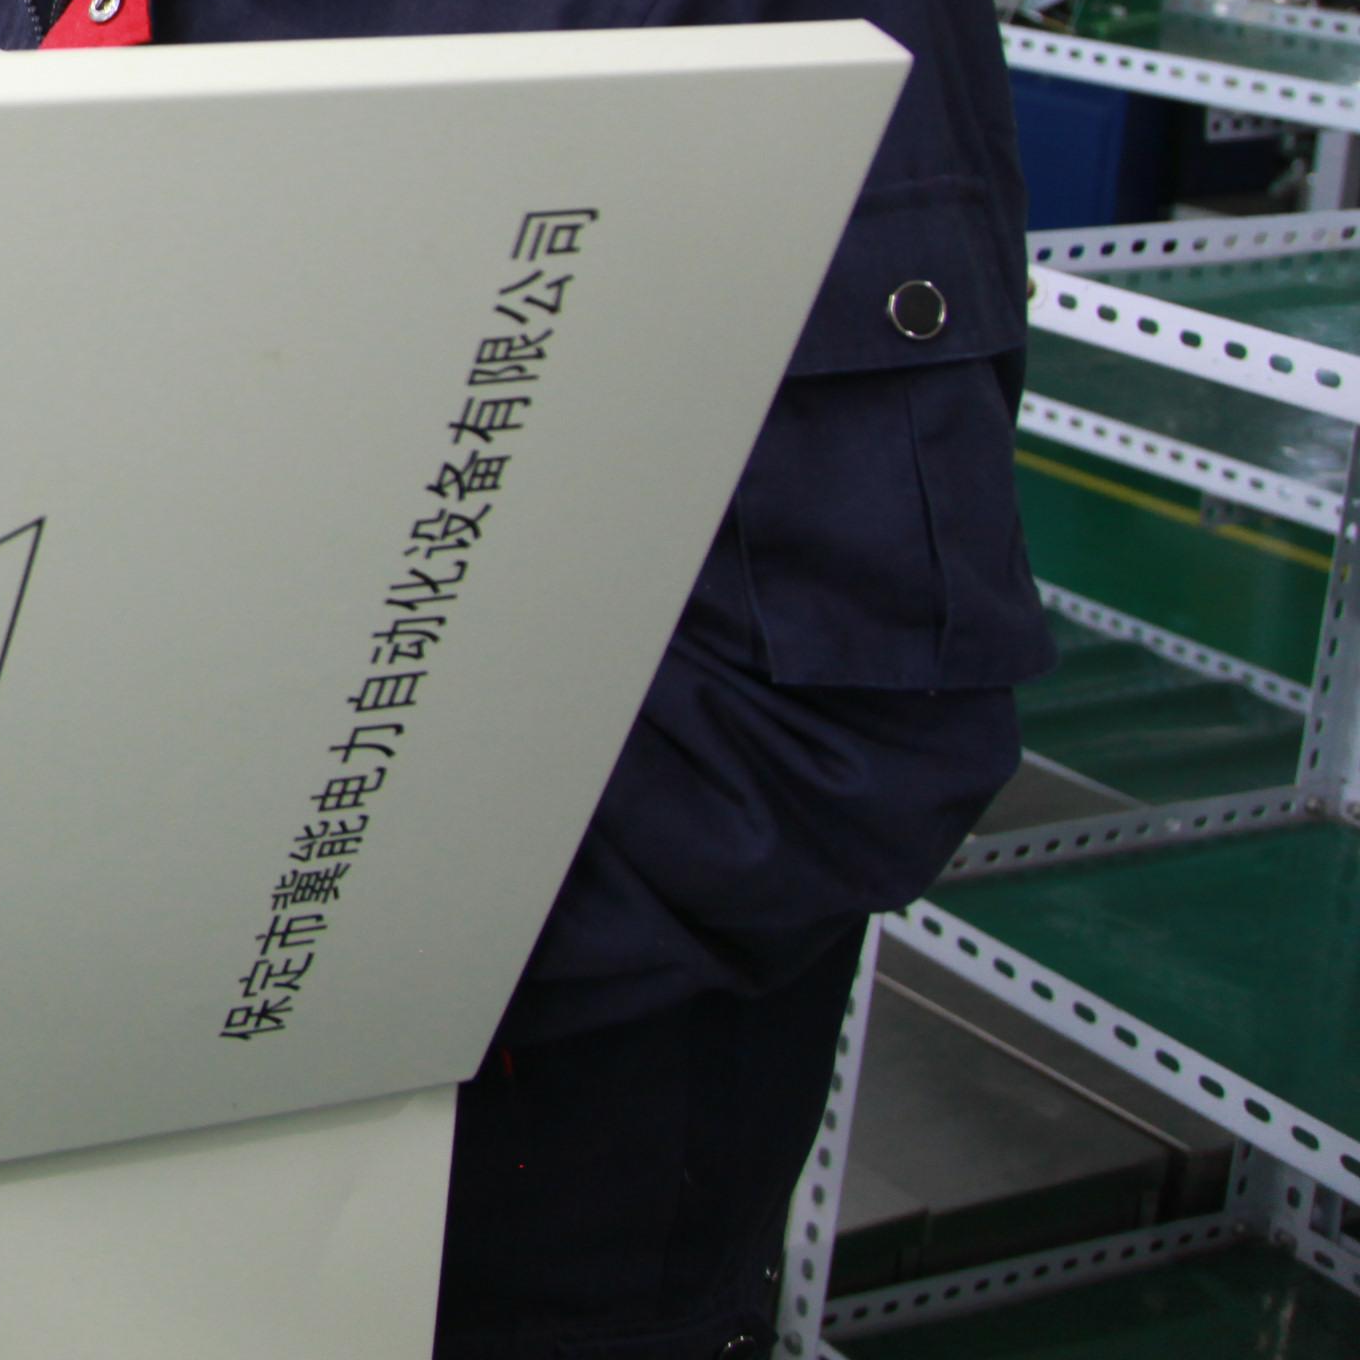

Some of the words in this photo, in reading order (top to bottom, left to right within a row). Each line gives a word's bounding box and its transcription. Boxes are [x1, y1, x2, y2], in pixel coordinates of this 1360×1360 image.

[218, 205, 600, 1042] 保定市冀能电力自动化设备有限公司
